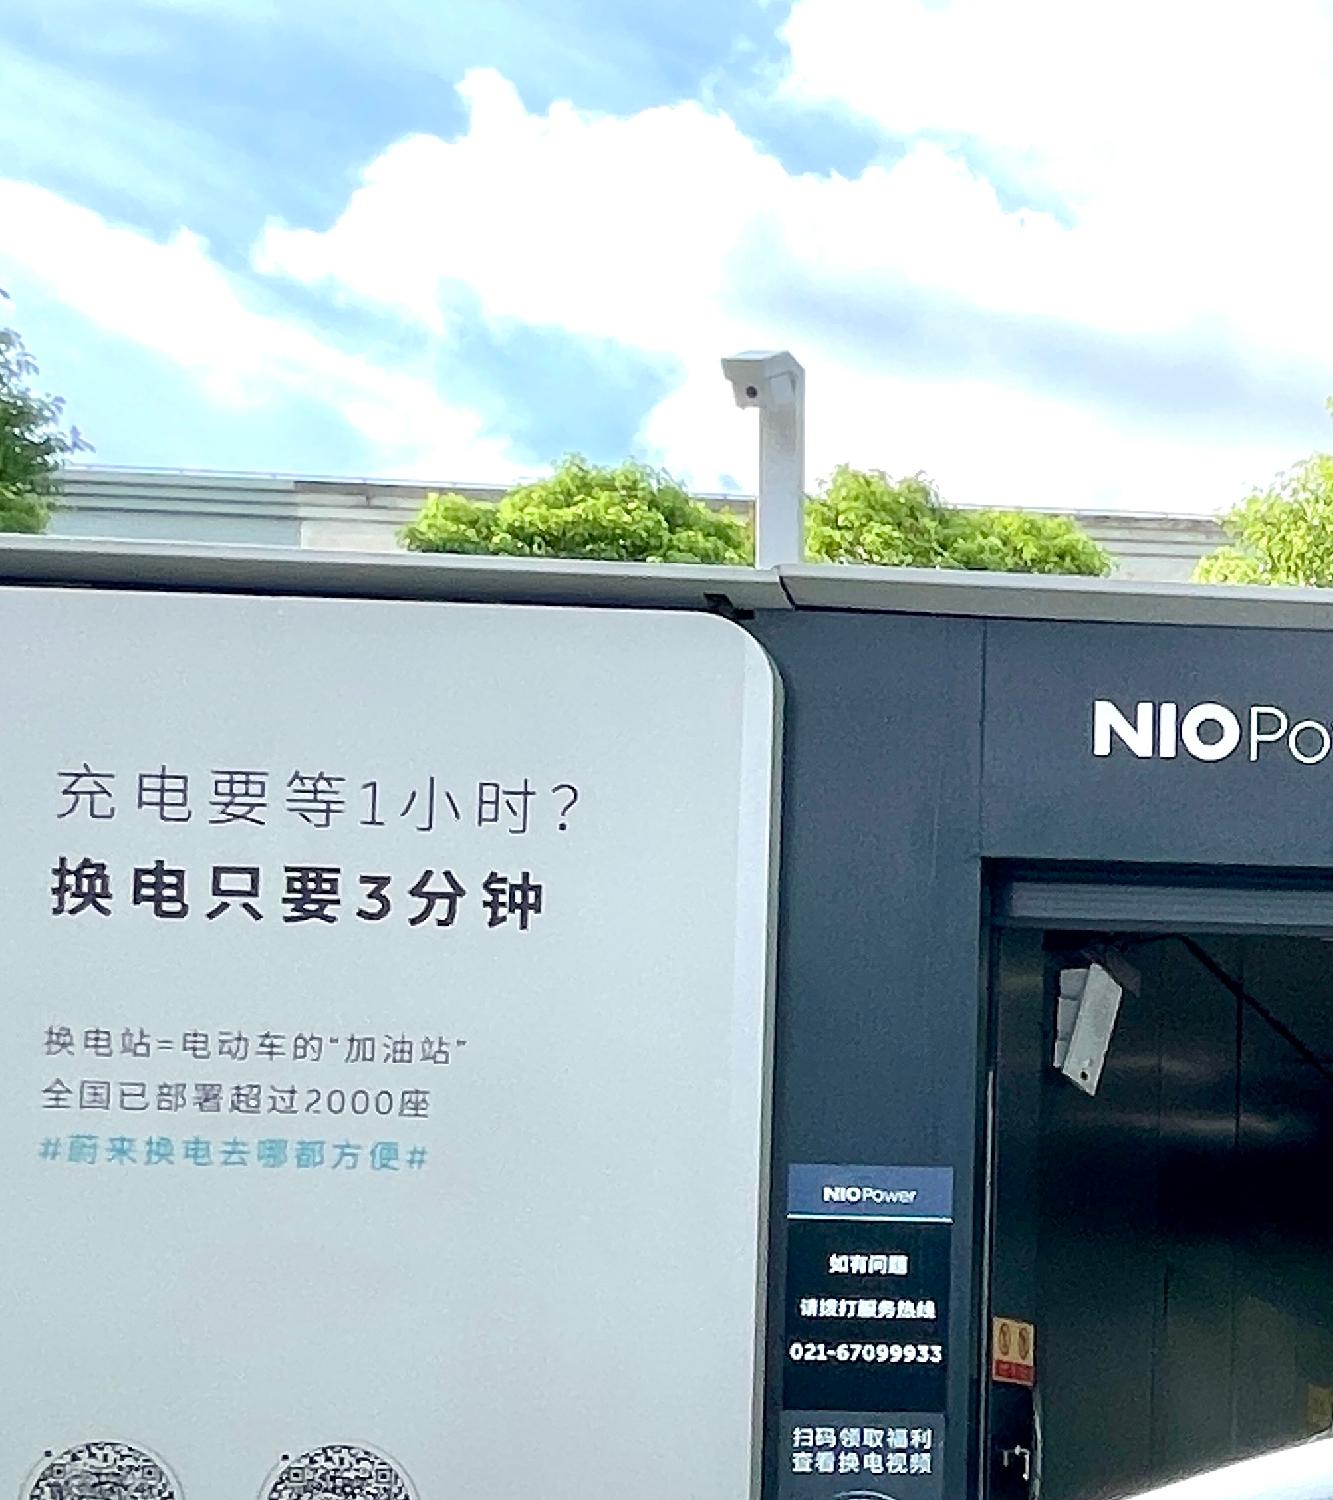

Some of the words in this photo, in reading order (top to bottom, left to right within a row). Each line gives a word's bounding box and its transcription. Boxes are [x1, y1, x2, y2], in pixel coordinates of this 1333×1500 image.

[1093, 699, 1241, 762] NIO
[55, 761, 584, 835] 充电要等1小时?
[50, 856, 545, 931] 换电只要3分钟
[40, 1077, 431, 1120] 全国已部署超过2000座
[38, 1134, 429, 1172] #蔚来换电去哪都方便#
[828, 1253, 909, 1276] 如有问题
[799, 1297, 937, 1320] 请拨打服务热线
[789, 1342, 943, 1364] 021-67099933
[791, 1426, 933, 1450] 扫码领取福利
[791, 1450, 932, 1475] 查看换电视频
